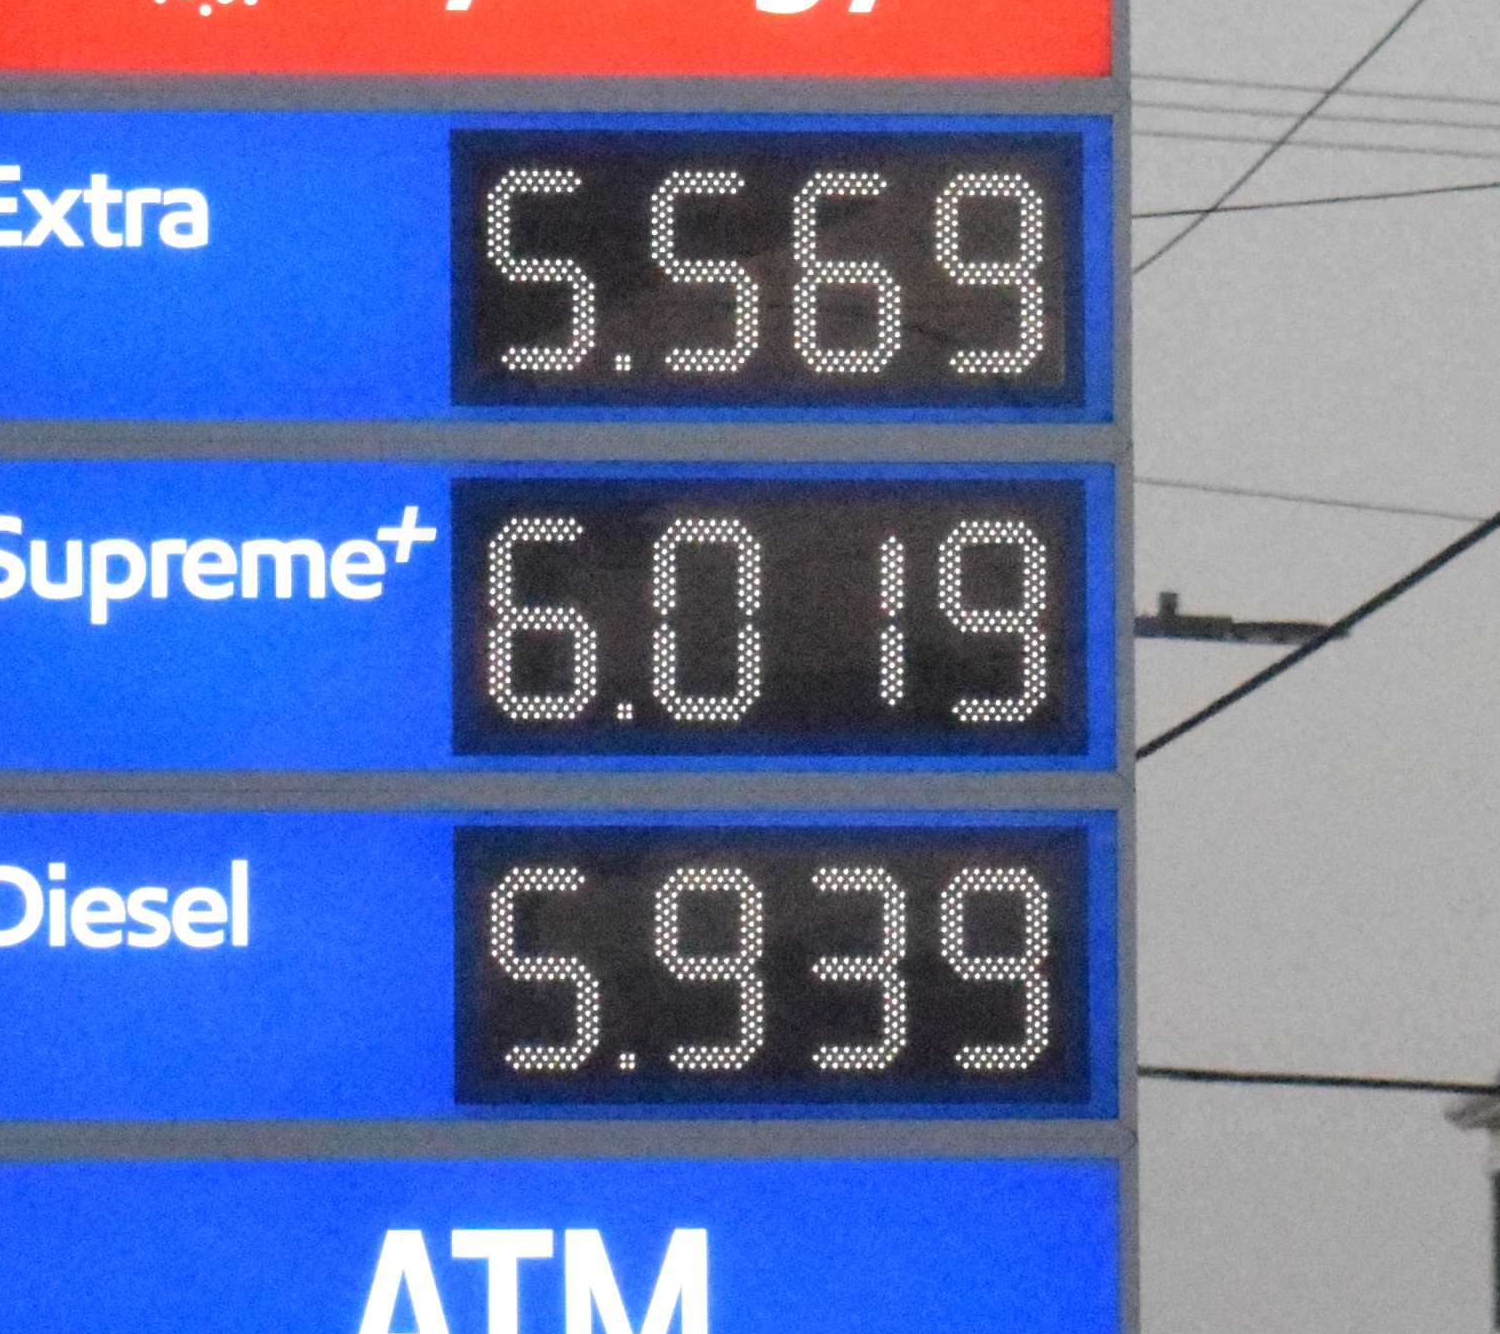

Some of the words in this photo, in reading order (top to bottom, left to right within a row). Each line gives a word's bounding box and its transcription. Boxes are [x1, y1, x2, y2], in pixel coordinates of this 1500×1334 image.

[486, 169, 1045, 375] 5.569
[487, 516, 1048, 723] 6.019
[489, 866, 1050, 1071] 5.939
